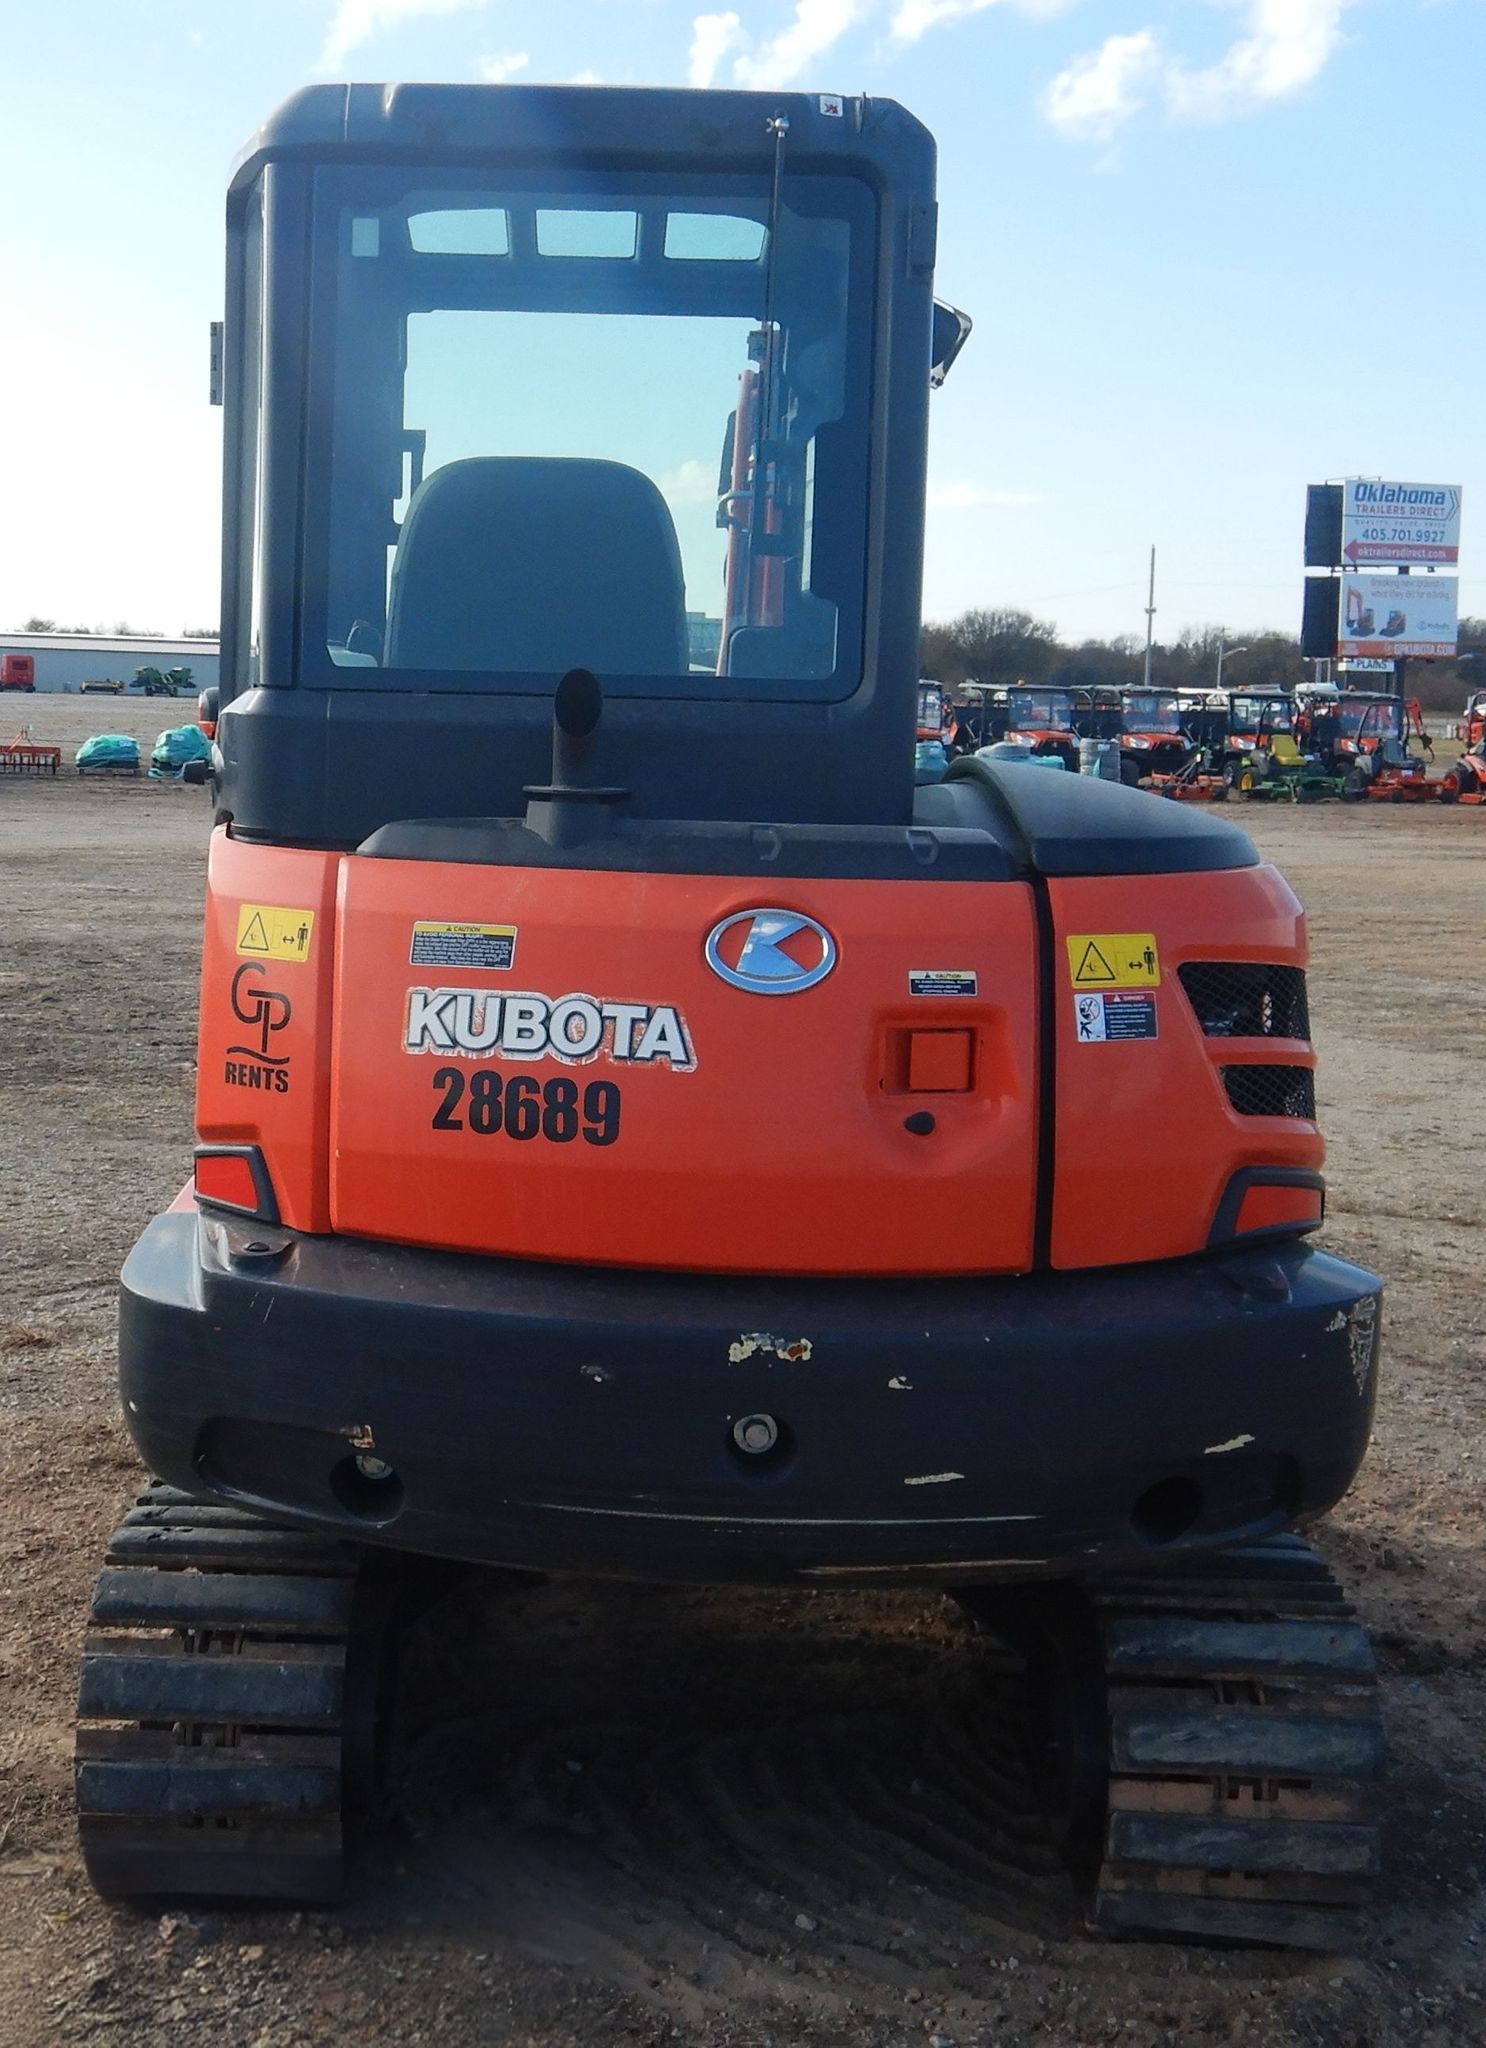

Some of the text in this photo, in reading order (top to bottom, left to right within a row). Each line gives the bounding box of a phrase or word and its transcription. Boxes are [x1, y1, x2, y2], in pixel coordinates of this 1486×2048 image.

[1354, 483, 1446, 505] Oklahoma
[1356, 504, 1446, 516] TRAILERS DIRECT
[1362, 528, 1446, 542] 405.701.9927
[1358, 546, 1447, 559] oktrailersdirect.com
[1356, 660, 1388, 669] PLAINS
[406, 991, 691, 1065] KUBOTA
[225, 1061, 289, 1093] RENTS
[432, 1067, 621, 1146] 28689
